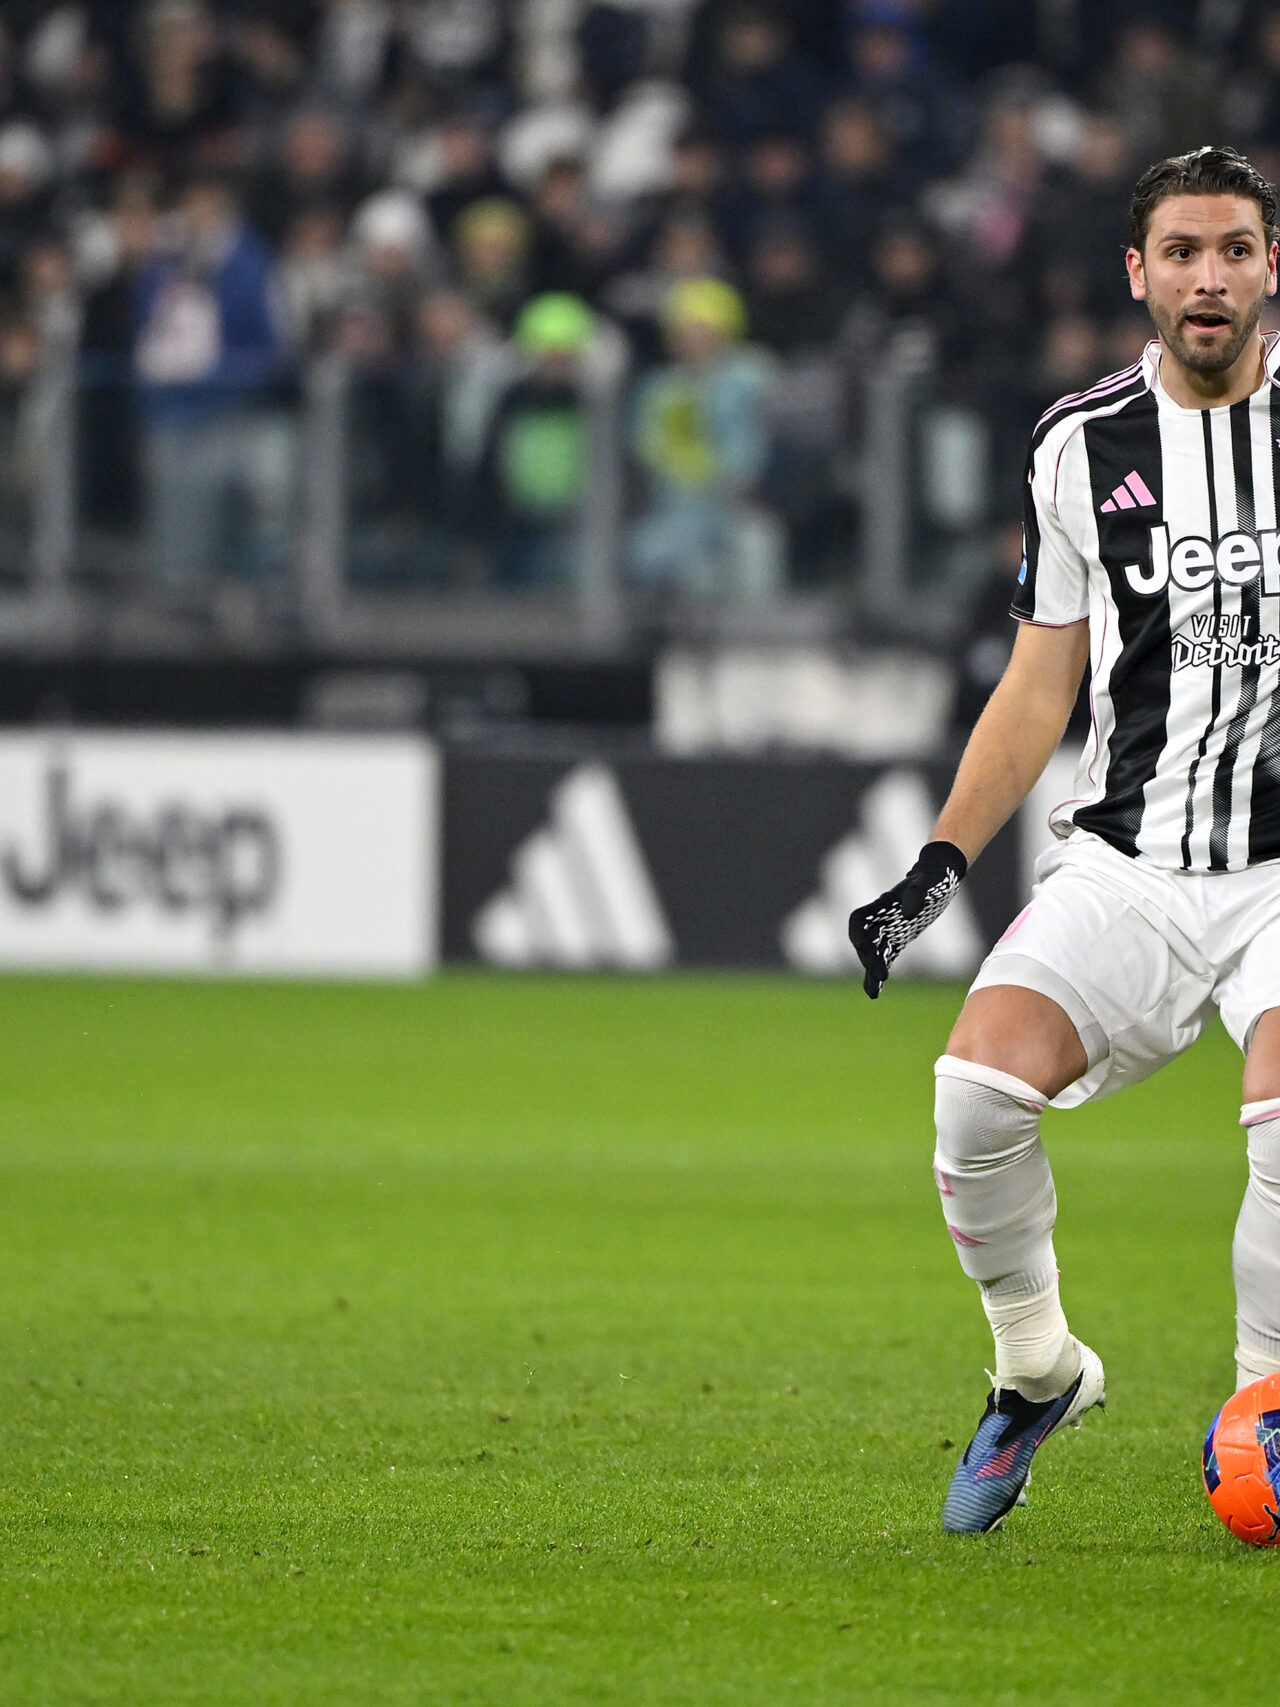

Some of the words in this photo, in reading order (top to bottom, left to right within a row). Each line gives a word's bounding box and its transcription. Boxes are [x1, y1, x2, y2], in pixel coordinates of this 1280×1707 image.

[1191, 614, 1251, 638] VISIT
[1171, 634, 1280, 673] Detroit
[2, 758, 283, 948] Jeep
